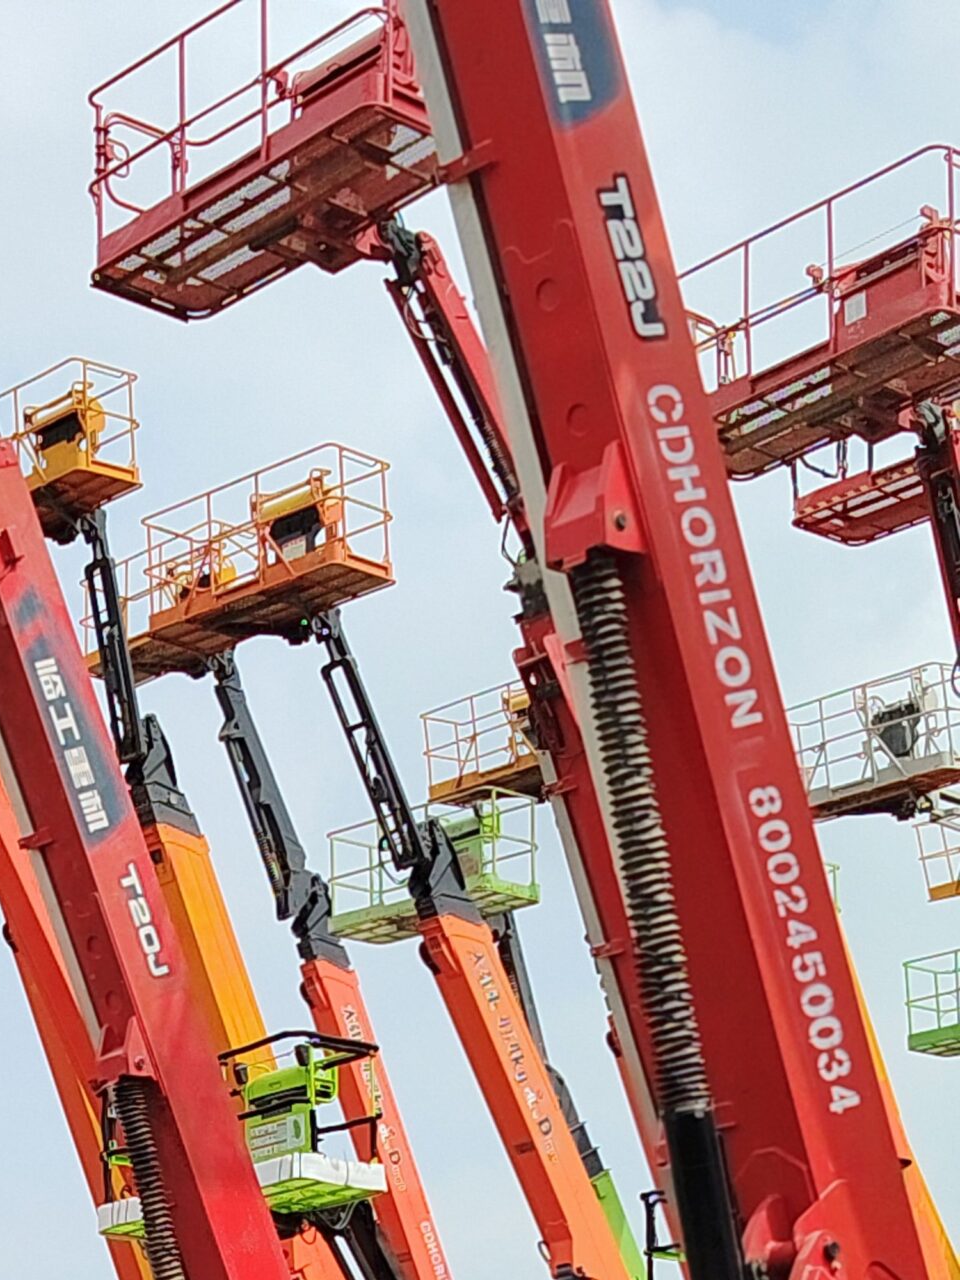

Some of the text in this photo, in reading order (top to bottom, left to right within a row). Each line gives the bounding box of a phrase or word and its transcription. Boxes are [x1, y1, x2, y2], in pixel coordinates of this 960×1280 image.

[597, 174, 667, 339] T22J
[34, 656, 110, 833] 临工重机
[646, 383, 861, 1115] CDHORIZON 8002450034
[119, 862, 170, 977] T20J
